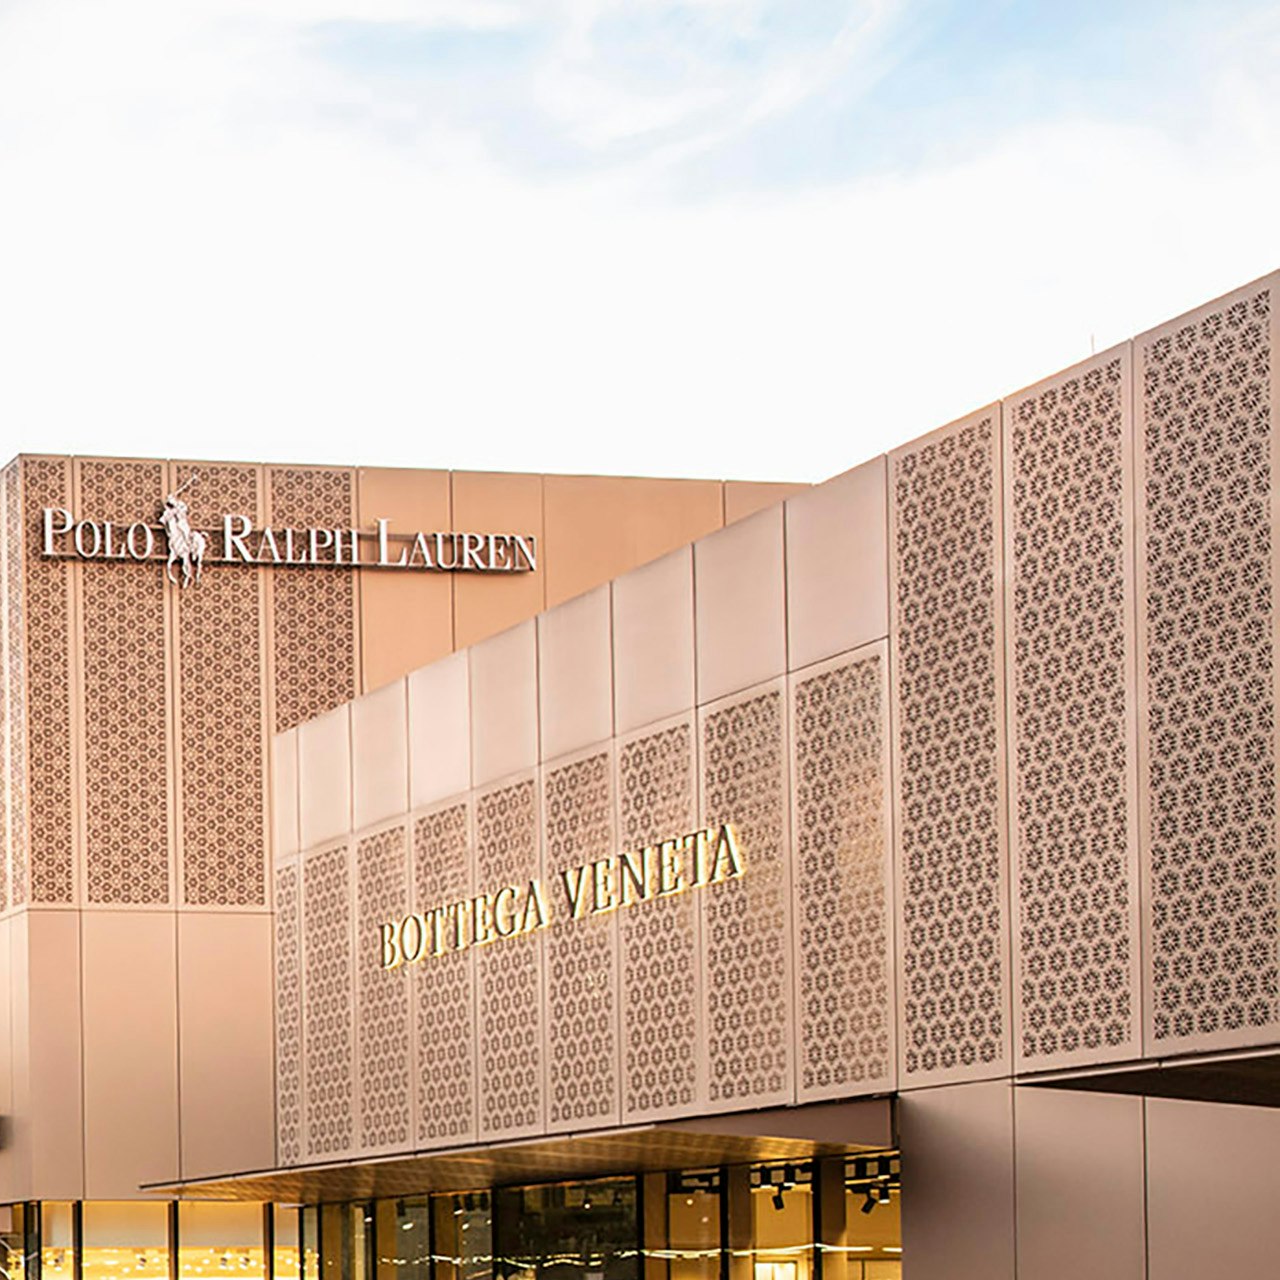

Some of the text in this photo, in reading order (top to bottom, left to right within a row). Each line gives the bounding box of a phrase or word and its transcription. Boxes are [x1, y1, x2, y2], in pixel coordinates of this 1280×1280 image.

[41, 506, 538, 572] POLO RALPH LAUREN
[378, 824, 745, 970] BOTTEGA VENETA
